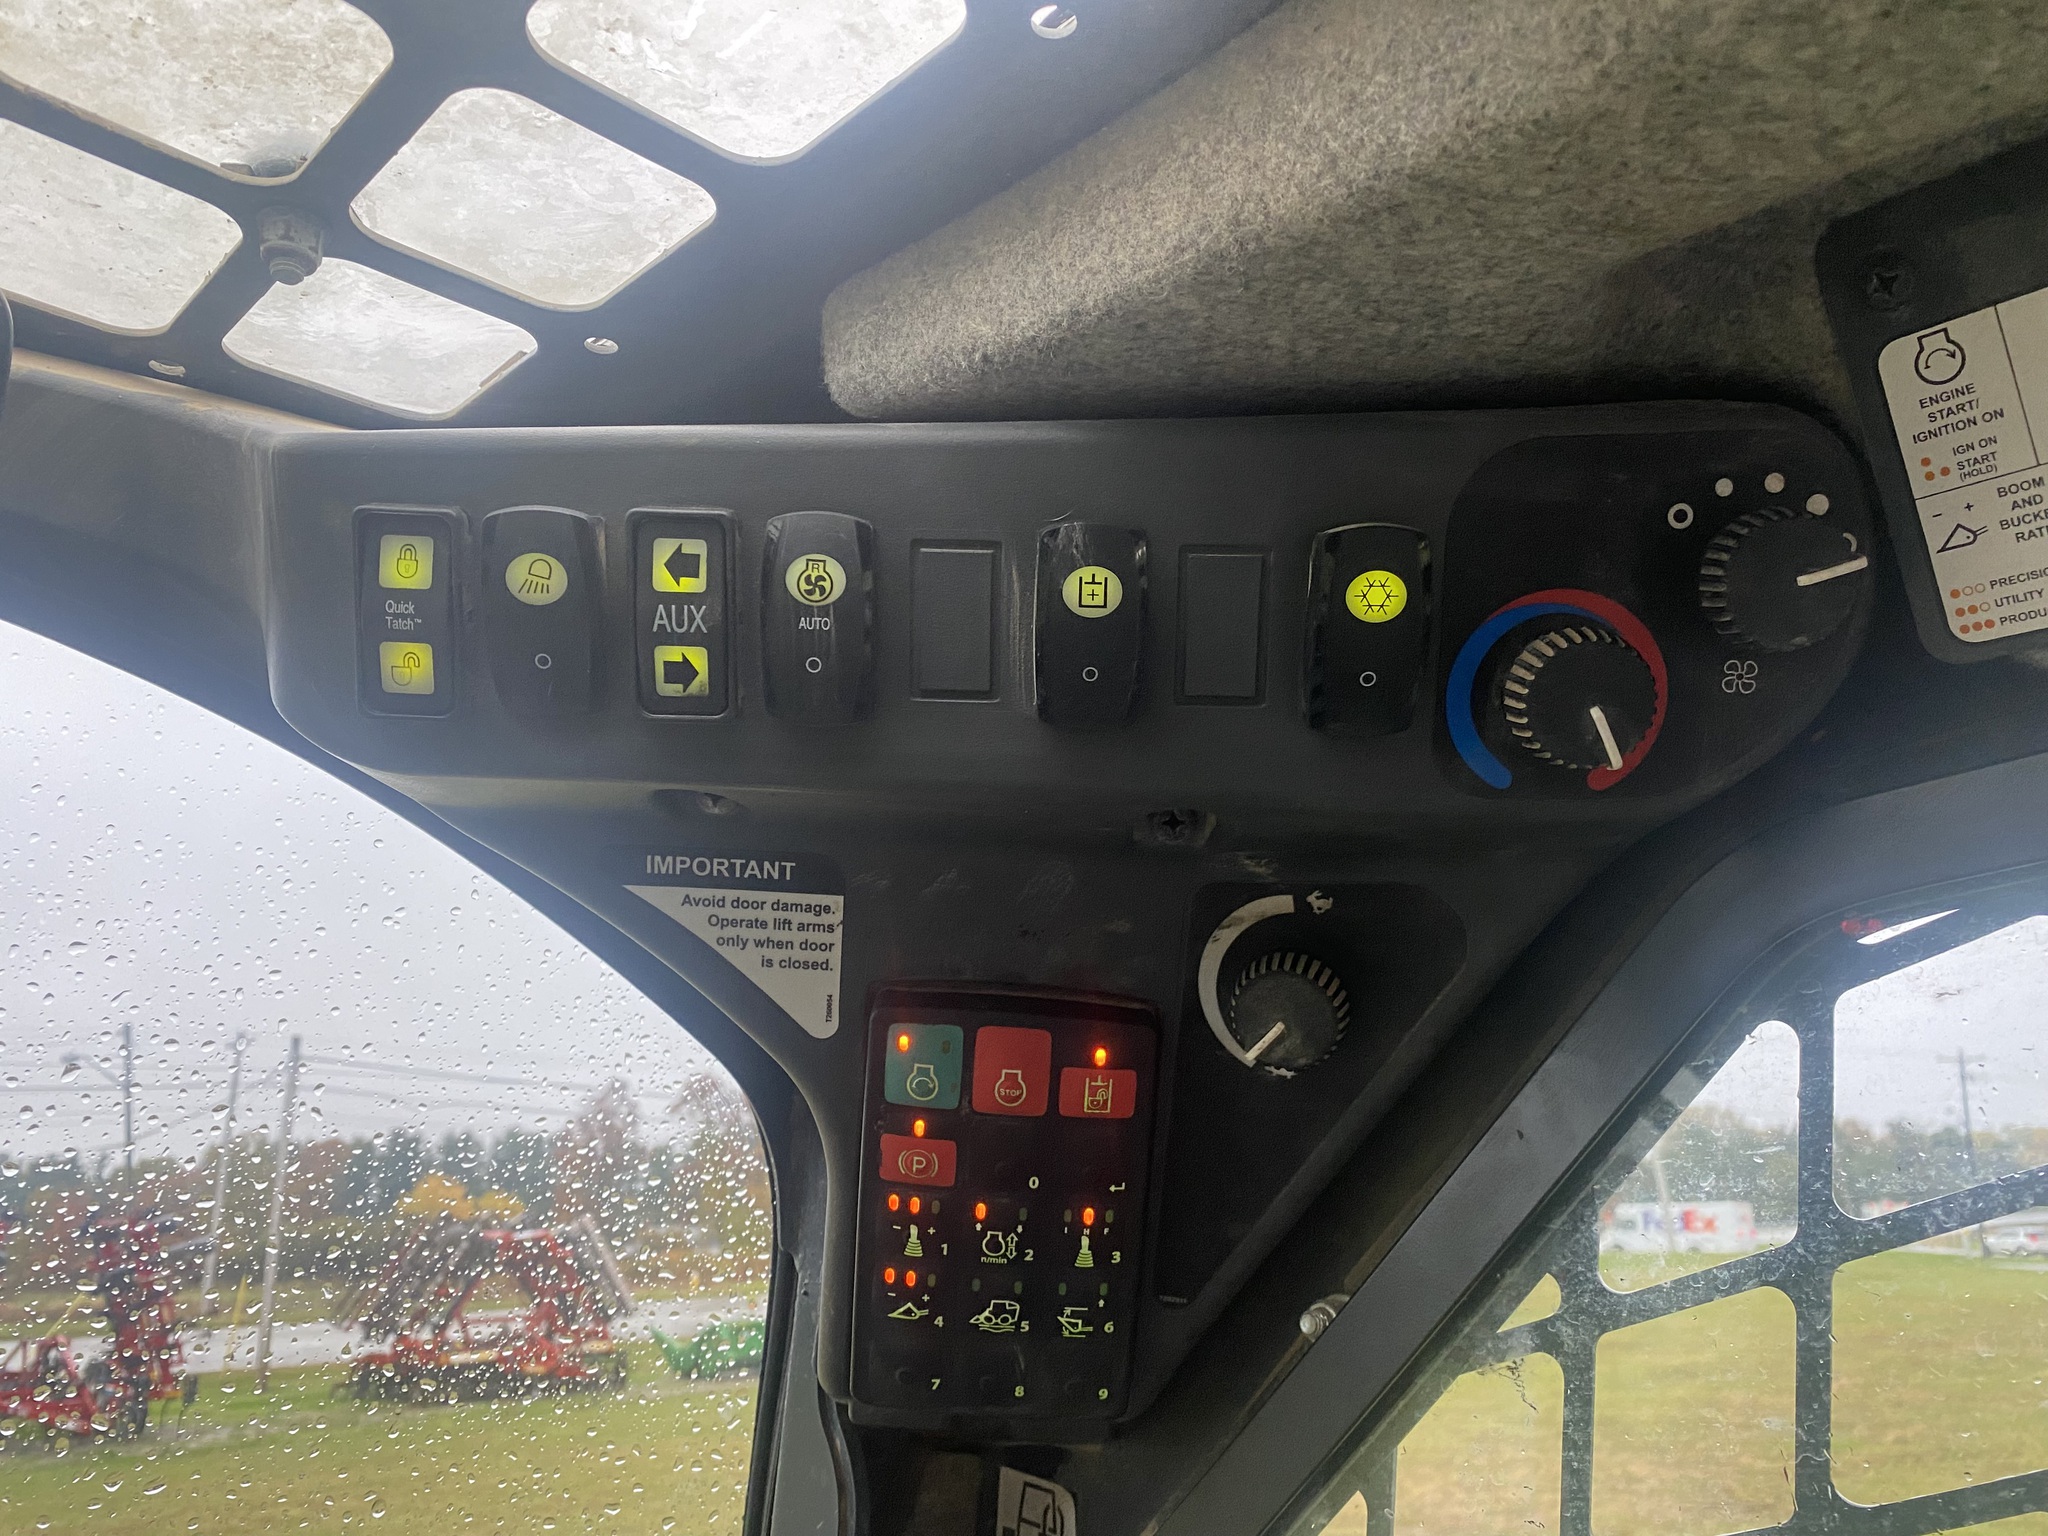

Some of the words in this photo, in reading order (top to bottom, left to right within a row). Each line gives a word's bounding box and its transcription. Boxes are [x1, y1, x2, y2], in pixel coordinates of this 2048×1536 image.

[1919, 383, 1976, 409] ENGINE
[1928, 398, 1980, 423] START/
[1912, 416, 1978, 444] IGNITION
[1981, 408, 2005, 423] ON
[1952, 442, 1975, 456] IGN
[1978, 435, 1998, 448] ON
[1956, 451, 1997, 471] START
[1960, 464, 1998, 482] (HOLD)
[1996, 476, 2045, 498] BOOM
[2011, 494, 2043, 511] AND
[2015, 525, 2048, 543] RAT
[1994, 588, 2044, 607] UTILITY
[385, 600, 415, 614] Quick
[652, 604, 708, 633] AUX
[798, 617, 831, 630] AUTO
[646, 855, 796, 880] IMPORTANT
[681, 894, 726, 908] Avoid
[730, 896, 767, 910] door
[771, 899, 836, 917] damage.
[708, 914, 768, 930] Operate
[773, 918, 792, 931] lift
[797, 921, 835, 933] arms
[716, 934, 749, 950] only
[753, 936, 794, 950] when
[799, 938, 835, 952] door
[761, 955, 774, 968] is
[778, 957, 834, 971] closed.
[1000, 1088, 1022, 1097] STOP
[913, 1156, 927, 1174] P
[1028, 1176, 1040, 1189] 0
[941, 1243, 949, 1256] 1
[1024, 1249, 1034, 1261] 2
[1111, 1251, 1121, 1264] 3
[981, 1256, 1008, 1264] n/min
[934, 1315, 944, 1328] 4
[1020, 1321, 1030, 1333] 5
[1104, 1321, 1114, 1333] 6
[931, 1378, 941, 1390] 7
[1014, 1385, 1025, 1398] 8
[1099, 1388, 1109, 1400] 9
